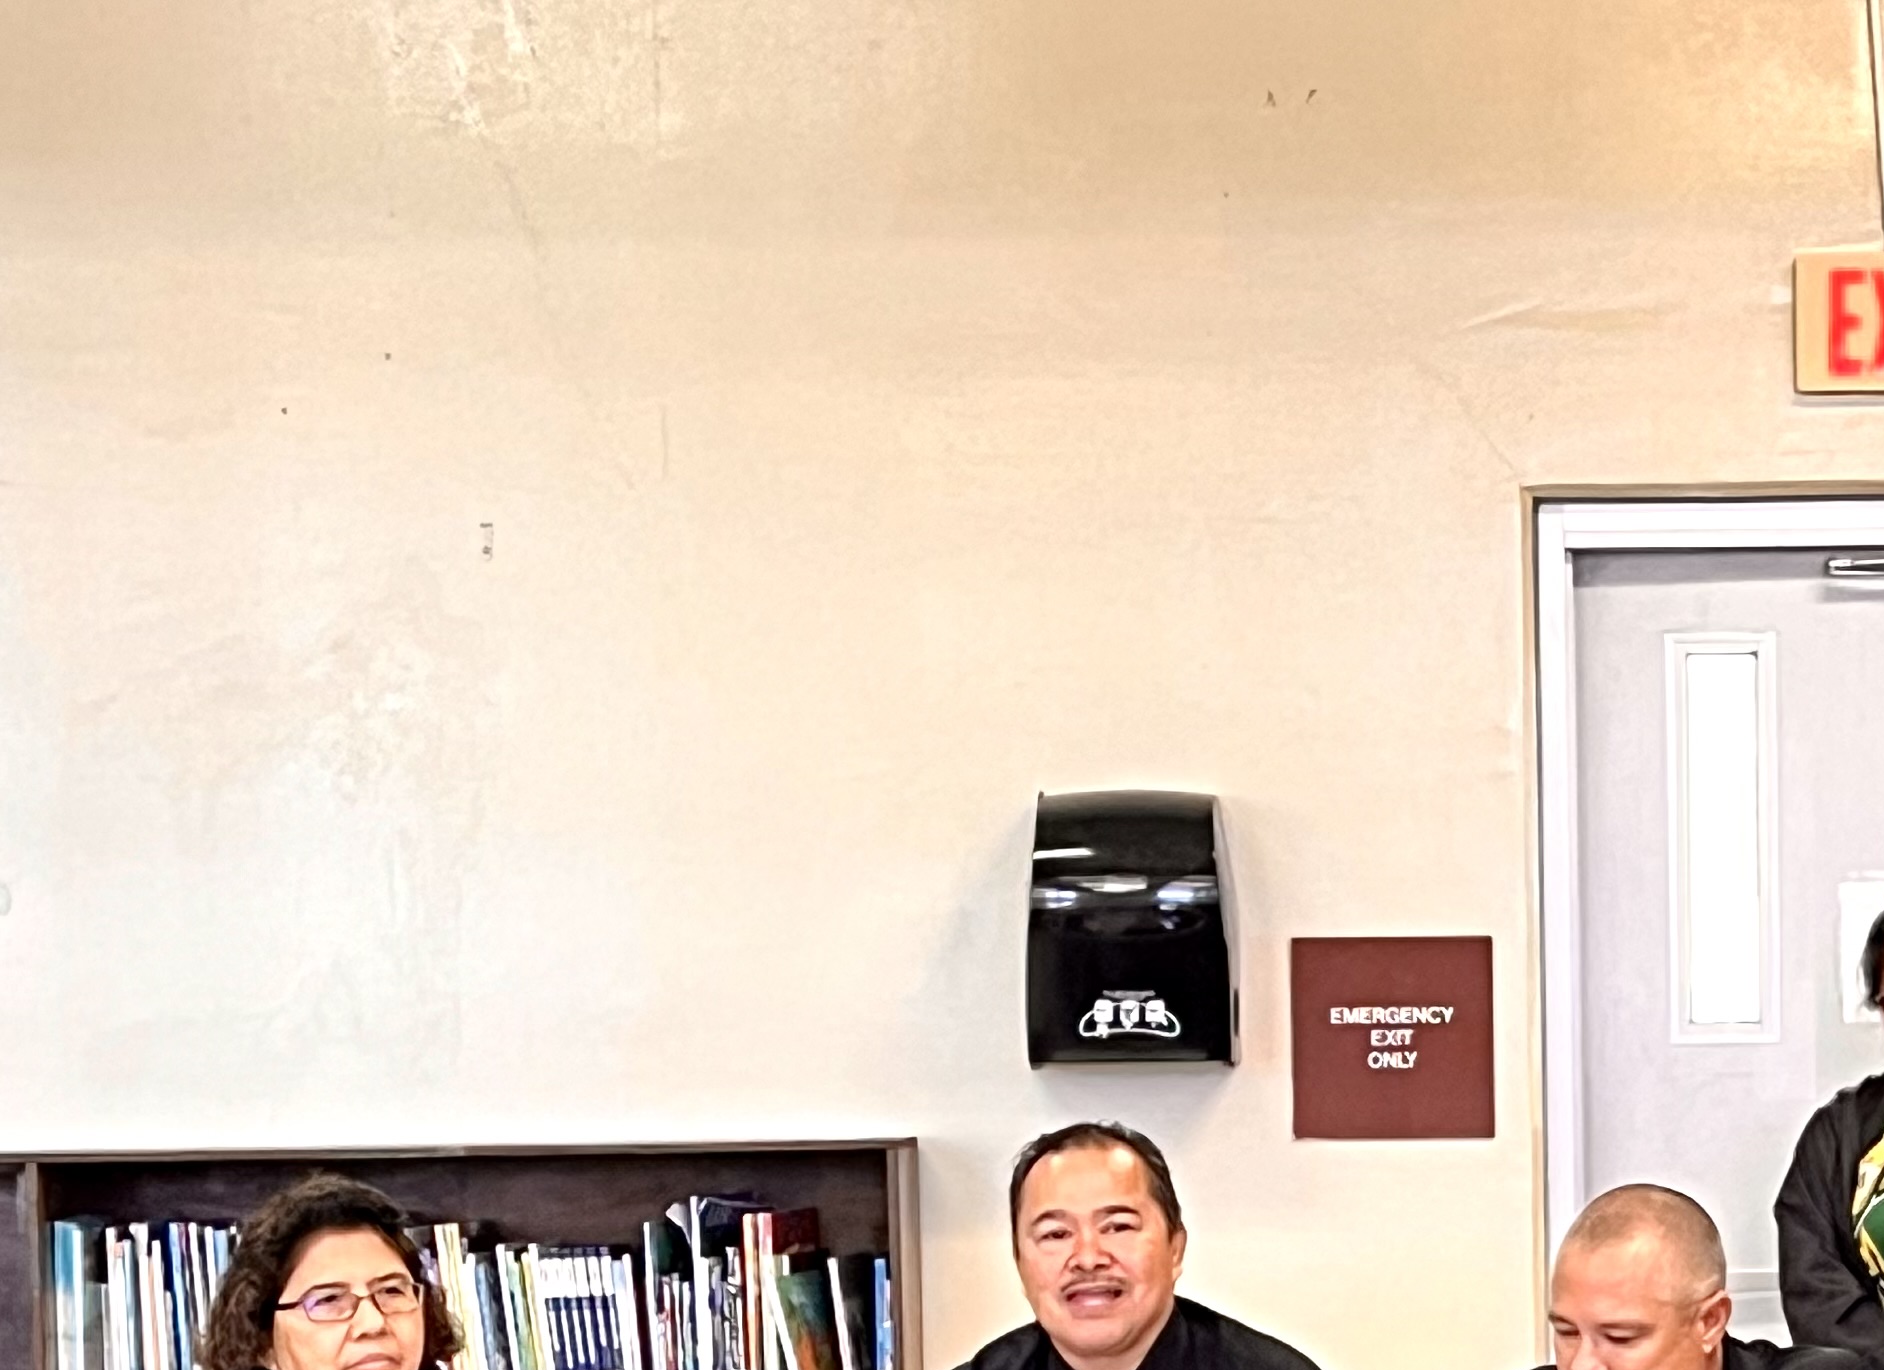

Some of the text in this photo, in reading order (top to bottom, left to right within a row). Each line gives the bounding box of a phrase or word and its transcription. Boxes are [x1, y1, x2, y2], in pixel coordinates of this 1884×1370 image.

[1329, 1006, 1454, 1024] EMERGENCY
[1370, 1029, 1414, 1047] EXIT
[1366, 1050, 1418, 1069] ONLY
